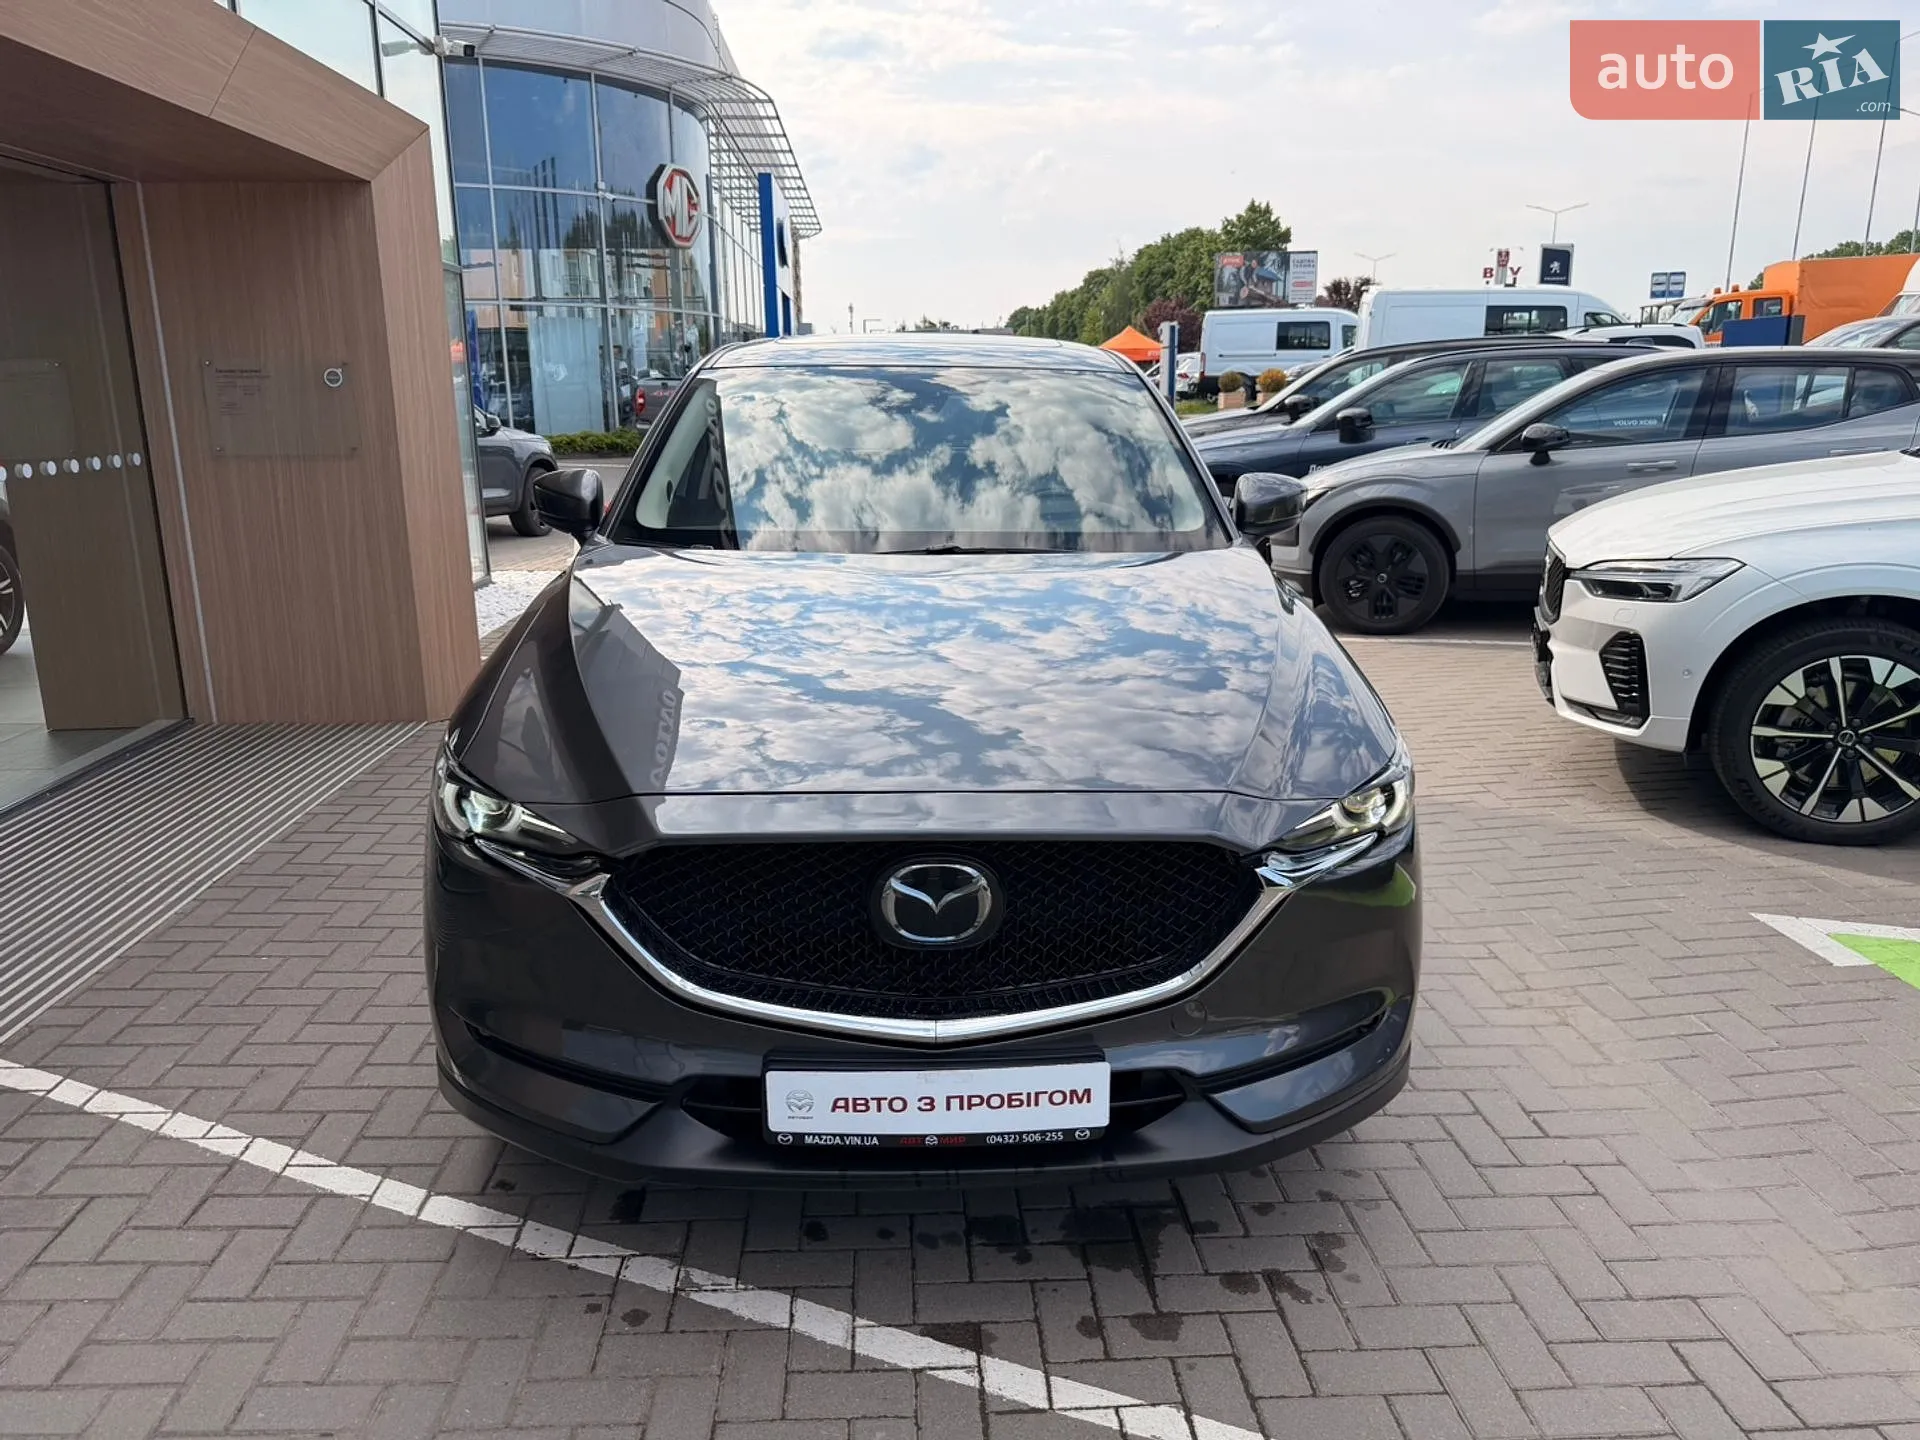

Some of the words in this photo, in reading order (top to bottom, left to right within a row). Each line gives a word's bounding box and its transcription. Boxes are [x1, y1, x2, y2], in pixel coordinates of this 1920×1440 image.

[831, 1096, 908, 1113] АВТО
[945, 1088, 1092, 1111] ПРОБІГОМ
[804, 1135, 879, 1146] MAZDA.VIN.UA
[986, 1135, 1020, 1145] (0432)
[1022, 1131, 1064, 1143] 506-255
